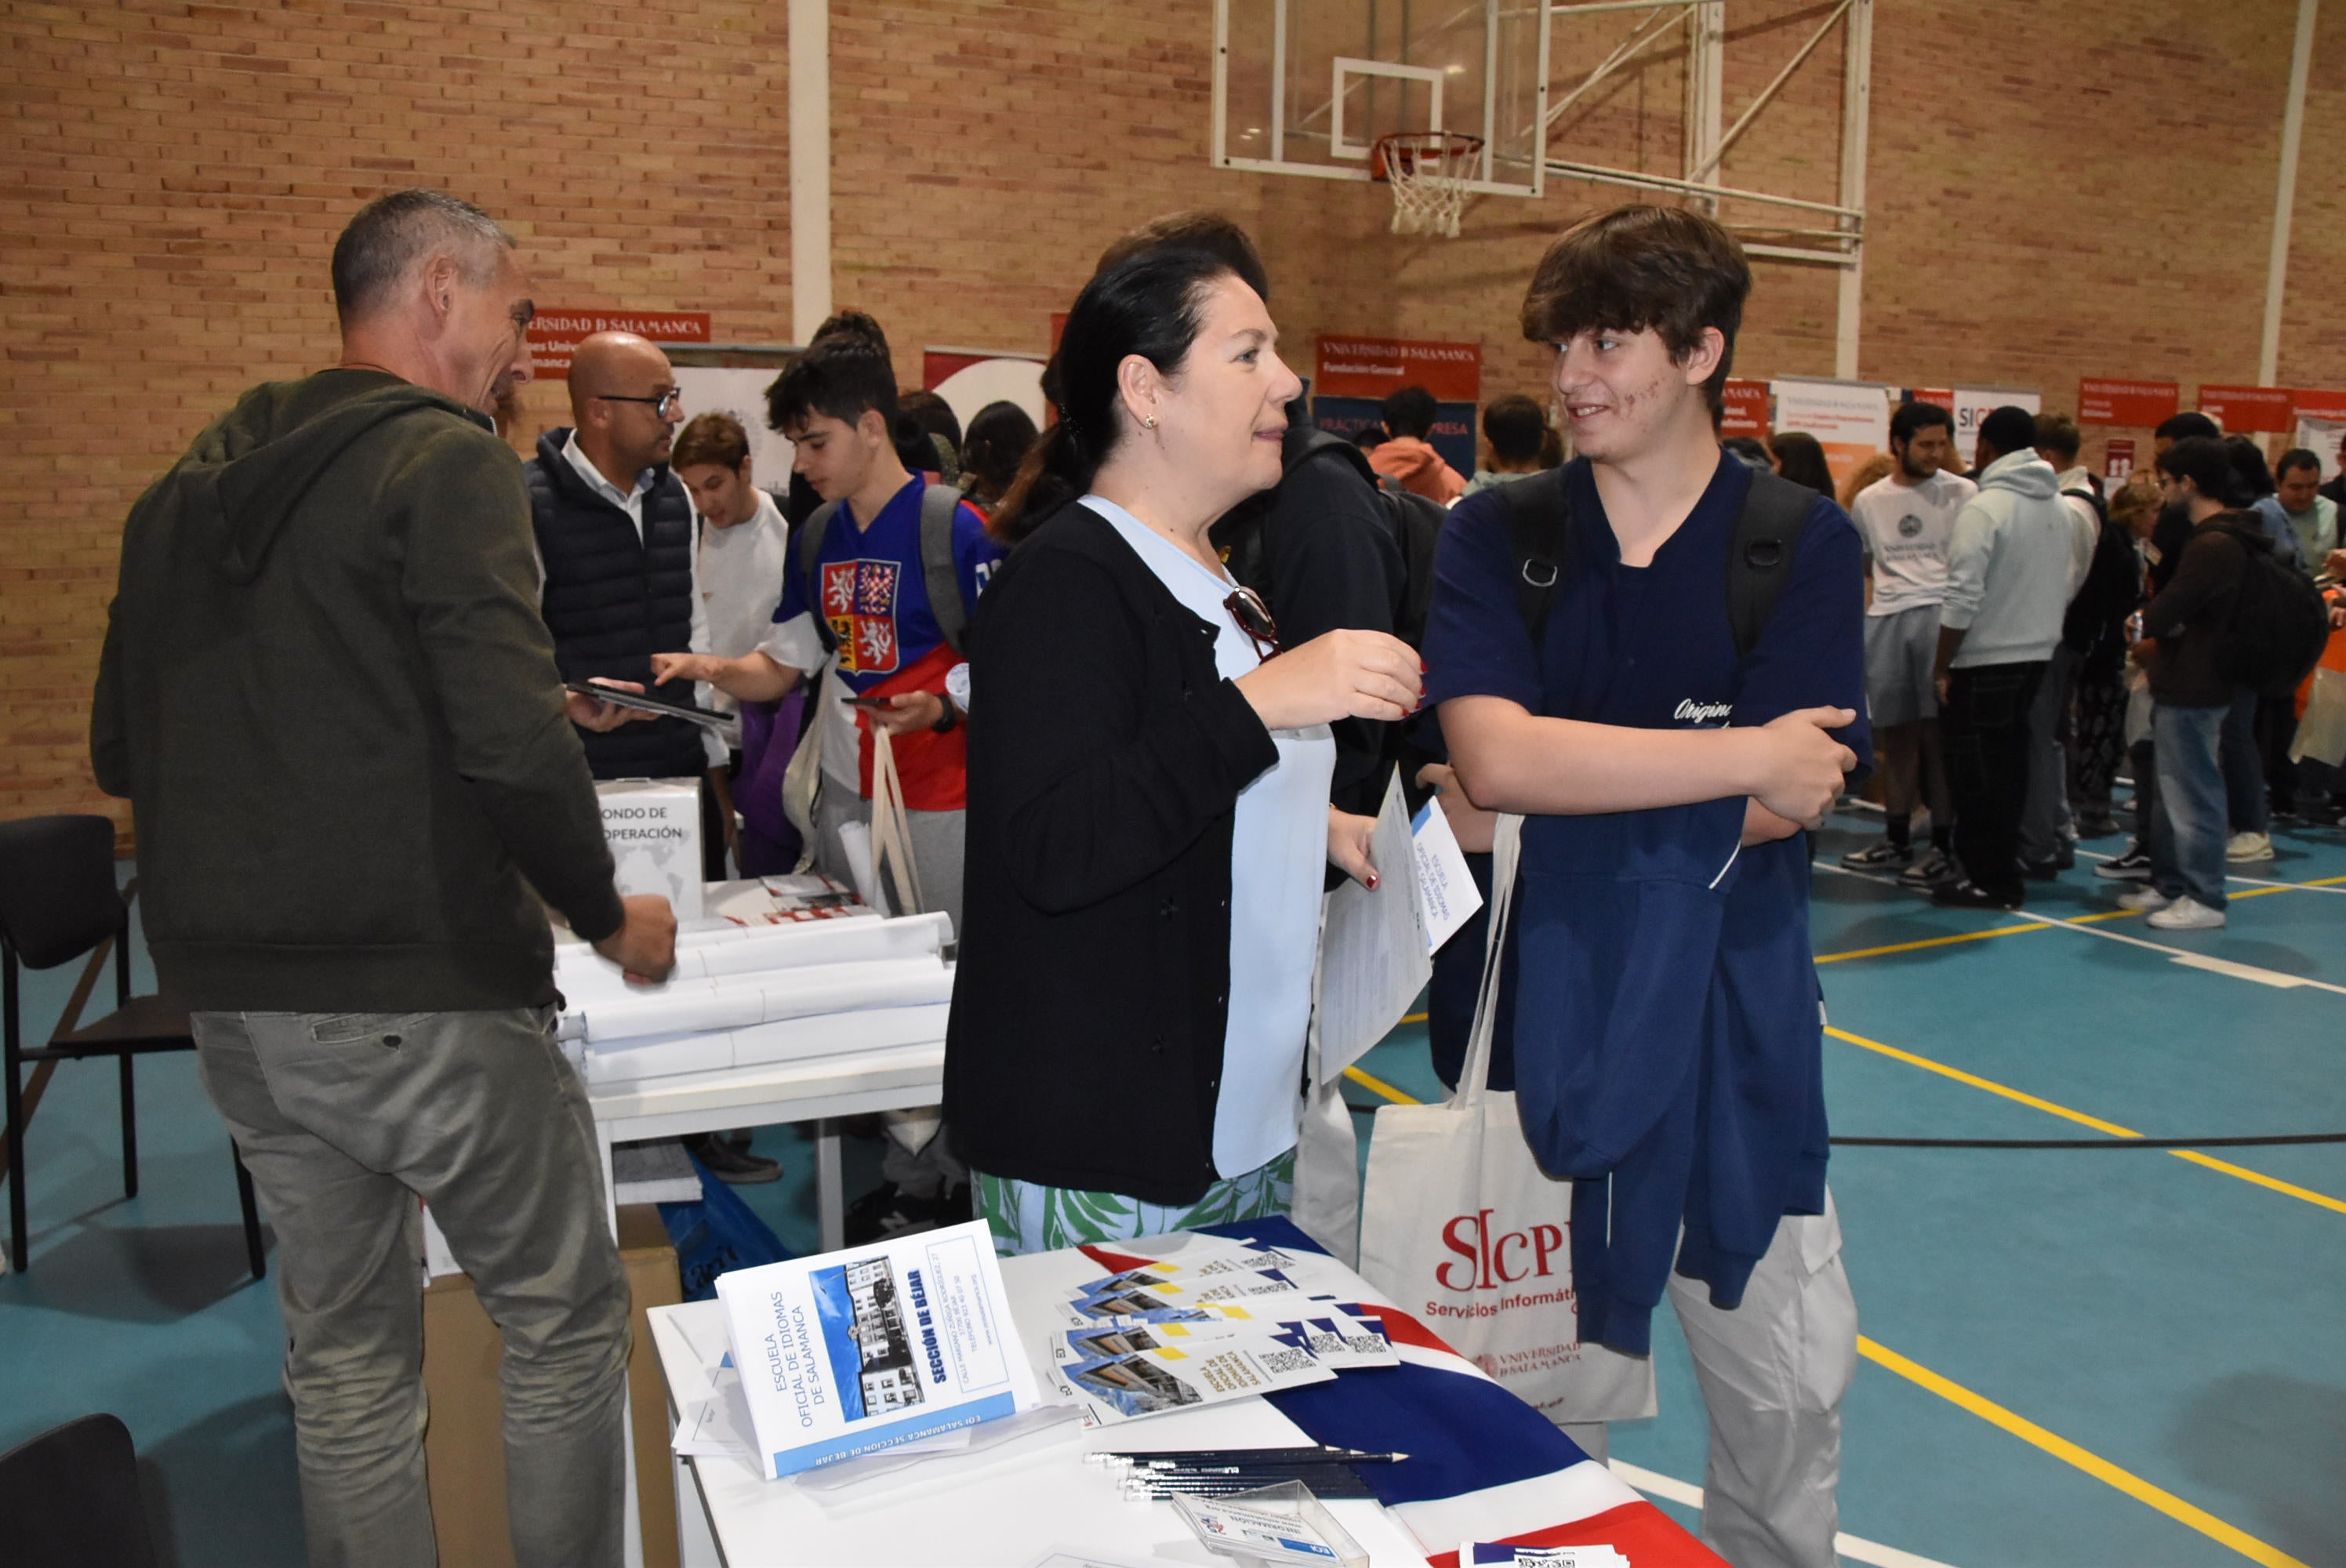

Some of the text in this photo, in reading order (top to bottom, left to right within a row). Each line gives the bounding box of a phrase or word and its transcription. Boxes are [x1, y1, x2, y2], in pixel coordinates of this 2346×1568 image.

[610, 318, 702, 335] SALAMANCA
[1959, 407, 1994, 428] SIC
[601, 807, 666, 820] ONDO DE
[603, 825, 682, 840] OPERACIÓN
[1426, 1301, 1498, 1319] Servicios
[907, 1269, 947, 1384] SECCIÓN DE BÉJAR
[764, 1334, 787, 1392] ESCUELA
[771, 1291, 812, 1428] OFICIAL DE IDIOMAS
[792, 1305, 825, 1405] DE SALAMANCA
[965, 1415, 981, 1425] EOI
[907, 1420, 964, 1441] SALAMANCA
[850, 1447, 862, 1457] DE
